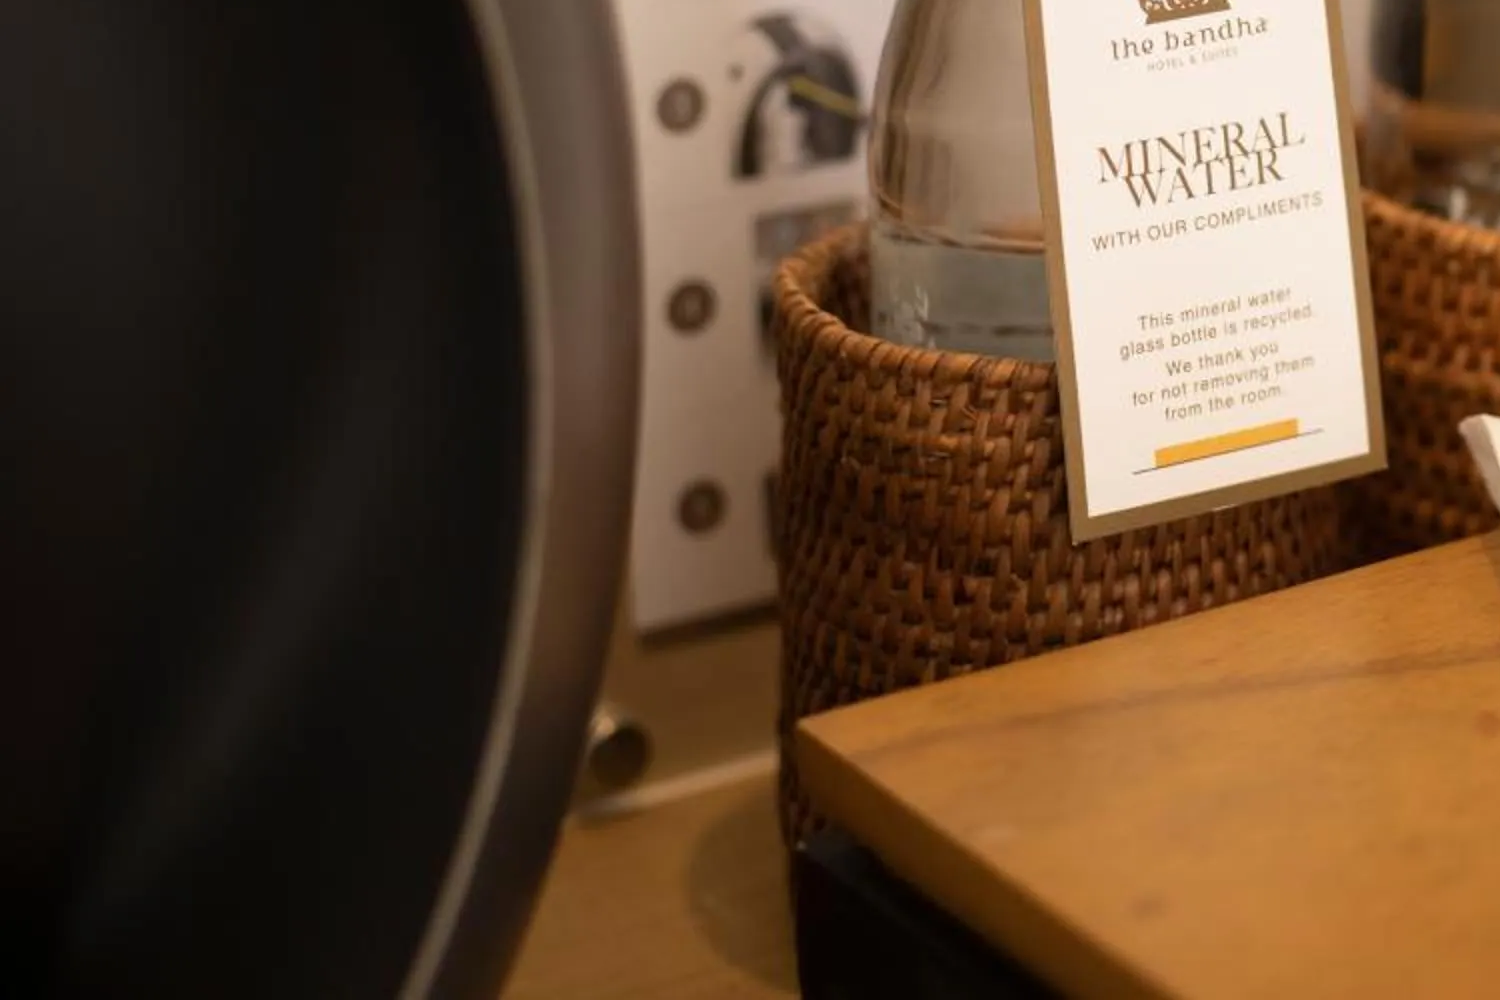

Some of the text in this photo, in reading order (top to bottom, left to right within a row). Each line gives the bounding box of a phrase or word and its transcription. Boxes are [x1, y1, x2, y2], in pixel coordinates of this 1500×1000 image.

[1111, 16, 1269, 61] the bandha
[1147, 57, 1184, 72] HOTEL
[1097, 112, 1305, 183] MINERAL
[1123, 149, 1286, 208] WATER
[1092, 191, 1324, 252] WITH OUR COMPLIMENTS
[1137, 287, 1292, 331] This mineral water
[1119, 338, 1165, 361] glass
[1171, 327, 1217, 347] bottle
[1224, 321, 1237, 335] is
[1165, 342, 1279, 377] We thank you
[1132, 354, 1316, 407] for not removing them
[1164, 402, 1203, 421] from
[1208, 394, 1235, 413] the
